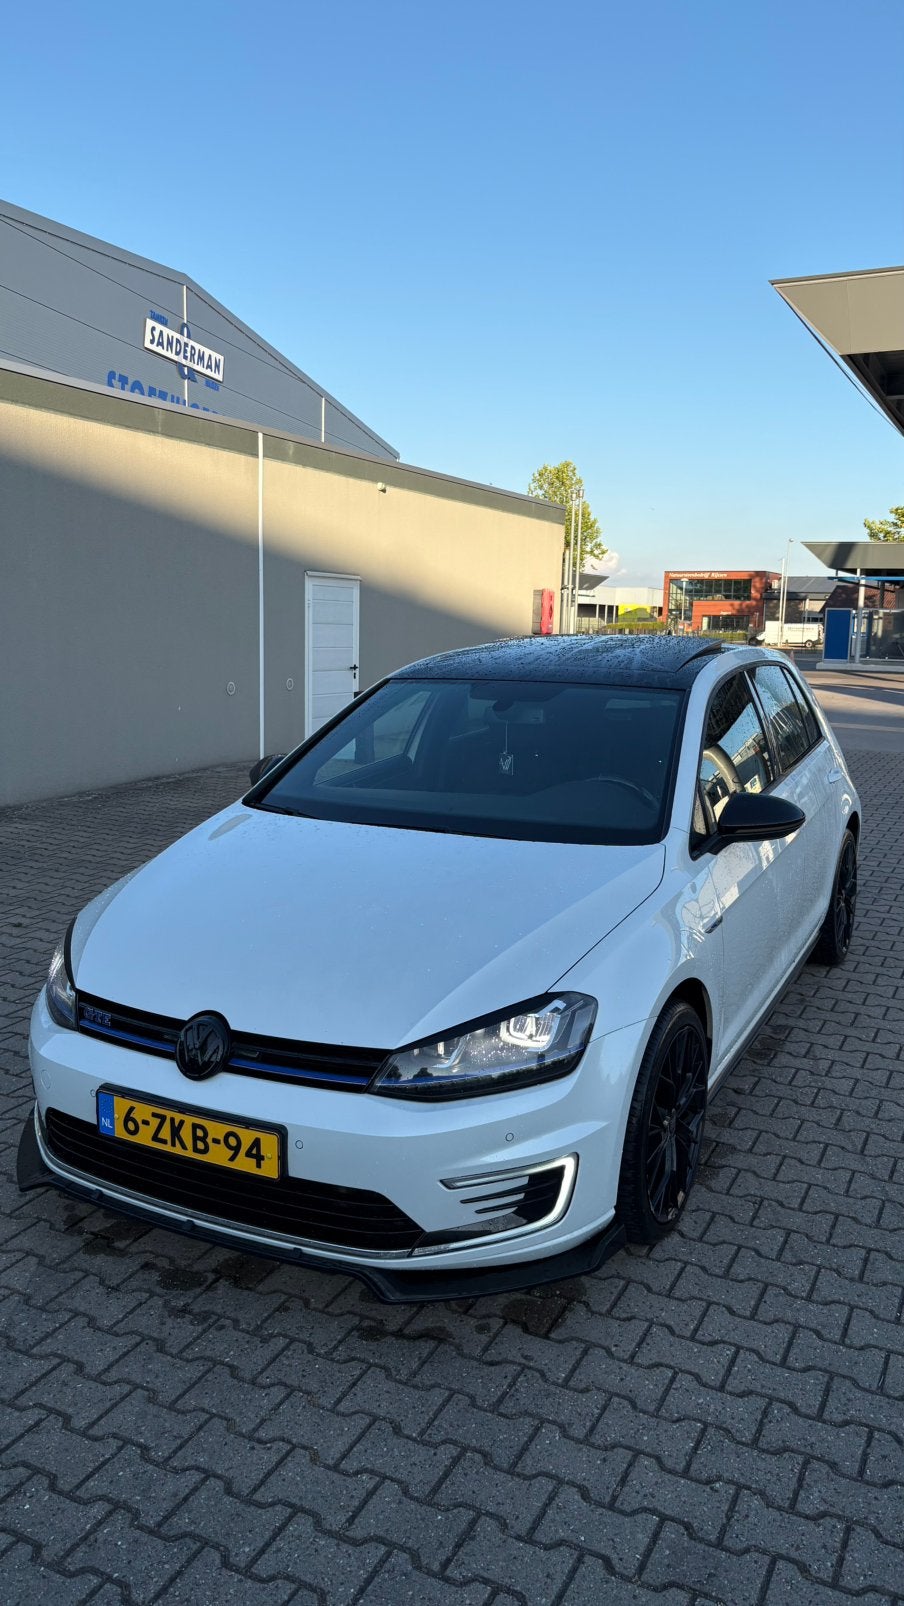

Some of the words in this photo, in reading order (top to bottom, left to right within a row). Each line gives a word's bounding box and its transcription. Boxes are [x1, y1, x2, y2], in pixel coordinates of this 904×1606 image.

[149, 325, 221, 375] SANDERMAN
[101, 1117, 113, 1129] NL
[122, 1105, 265, 1169] 6-ZKB-94
